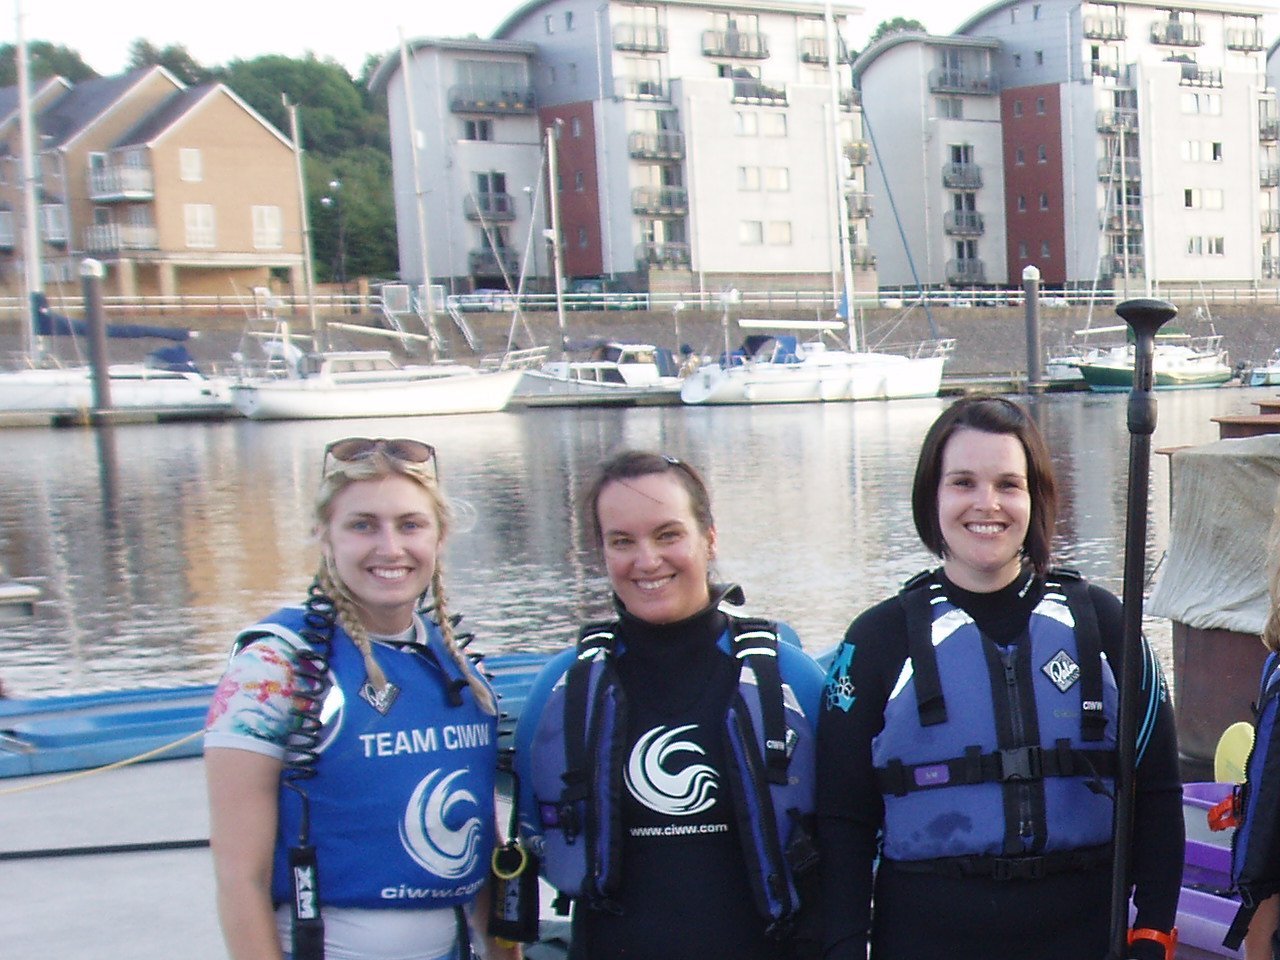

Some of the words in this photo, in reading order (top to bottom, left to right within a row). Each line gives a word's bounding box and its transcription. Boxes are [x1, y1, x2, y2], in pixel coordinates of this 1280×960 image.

[359, 727, 438, 758] TEAM
[442, 722, 490, 751] CIWW
[629, 822, 729, 837] www.ciww.com
